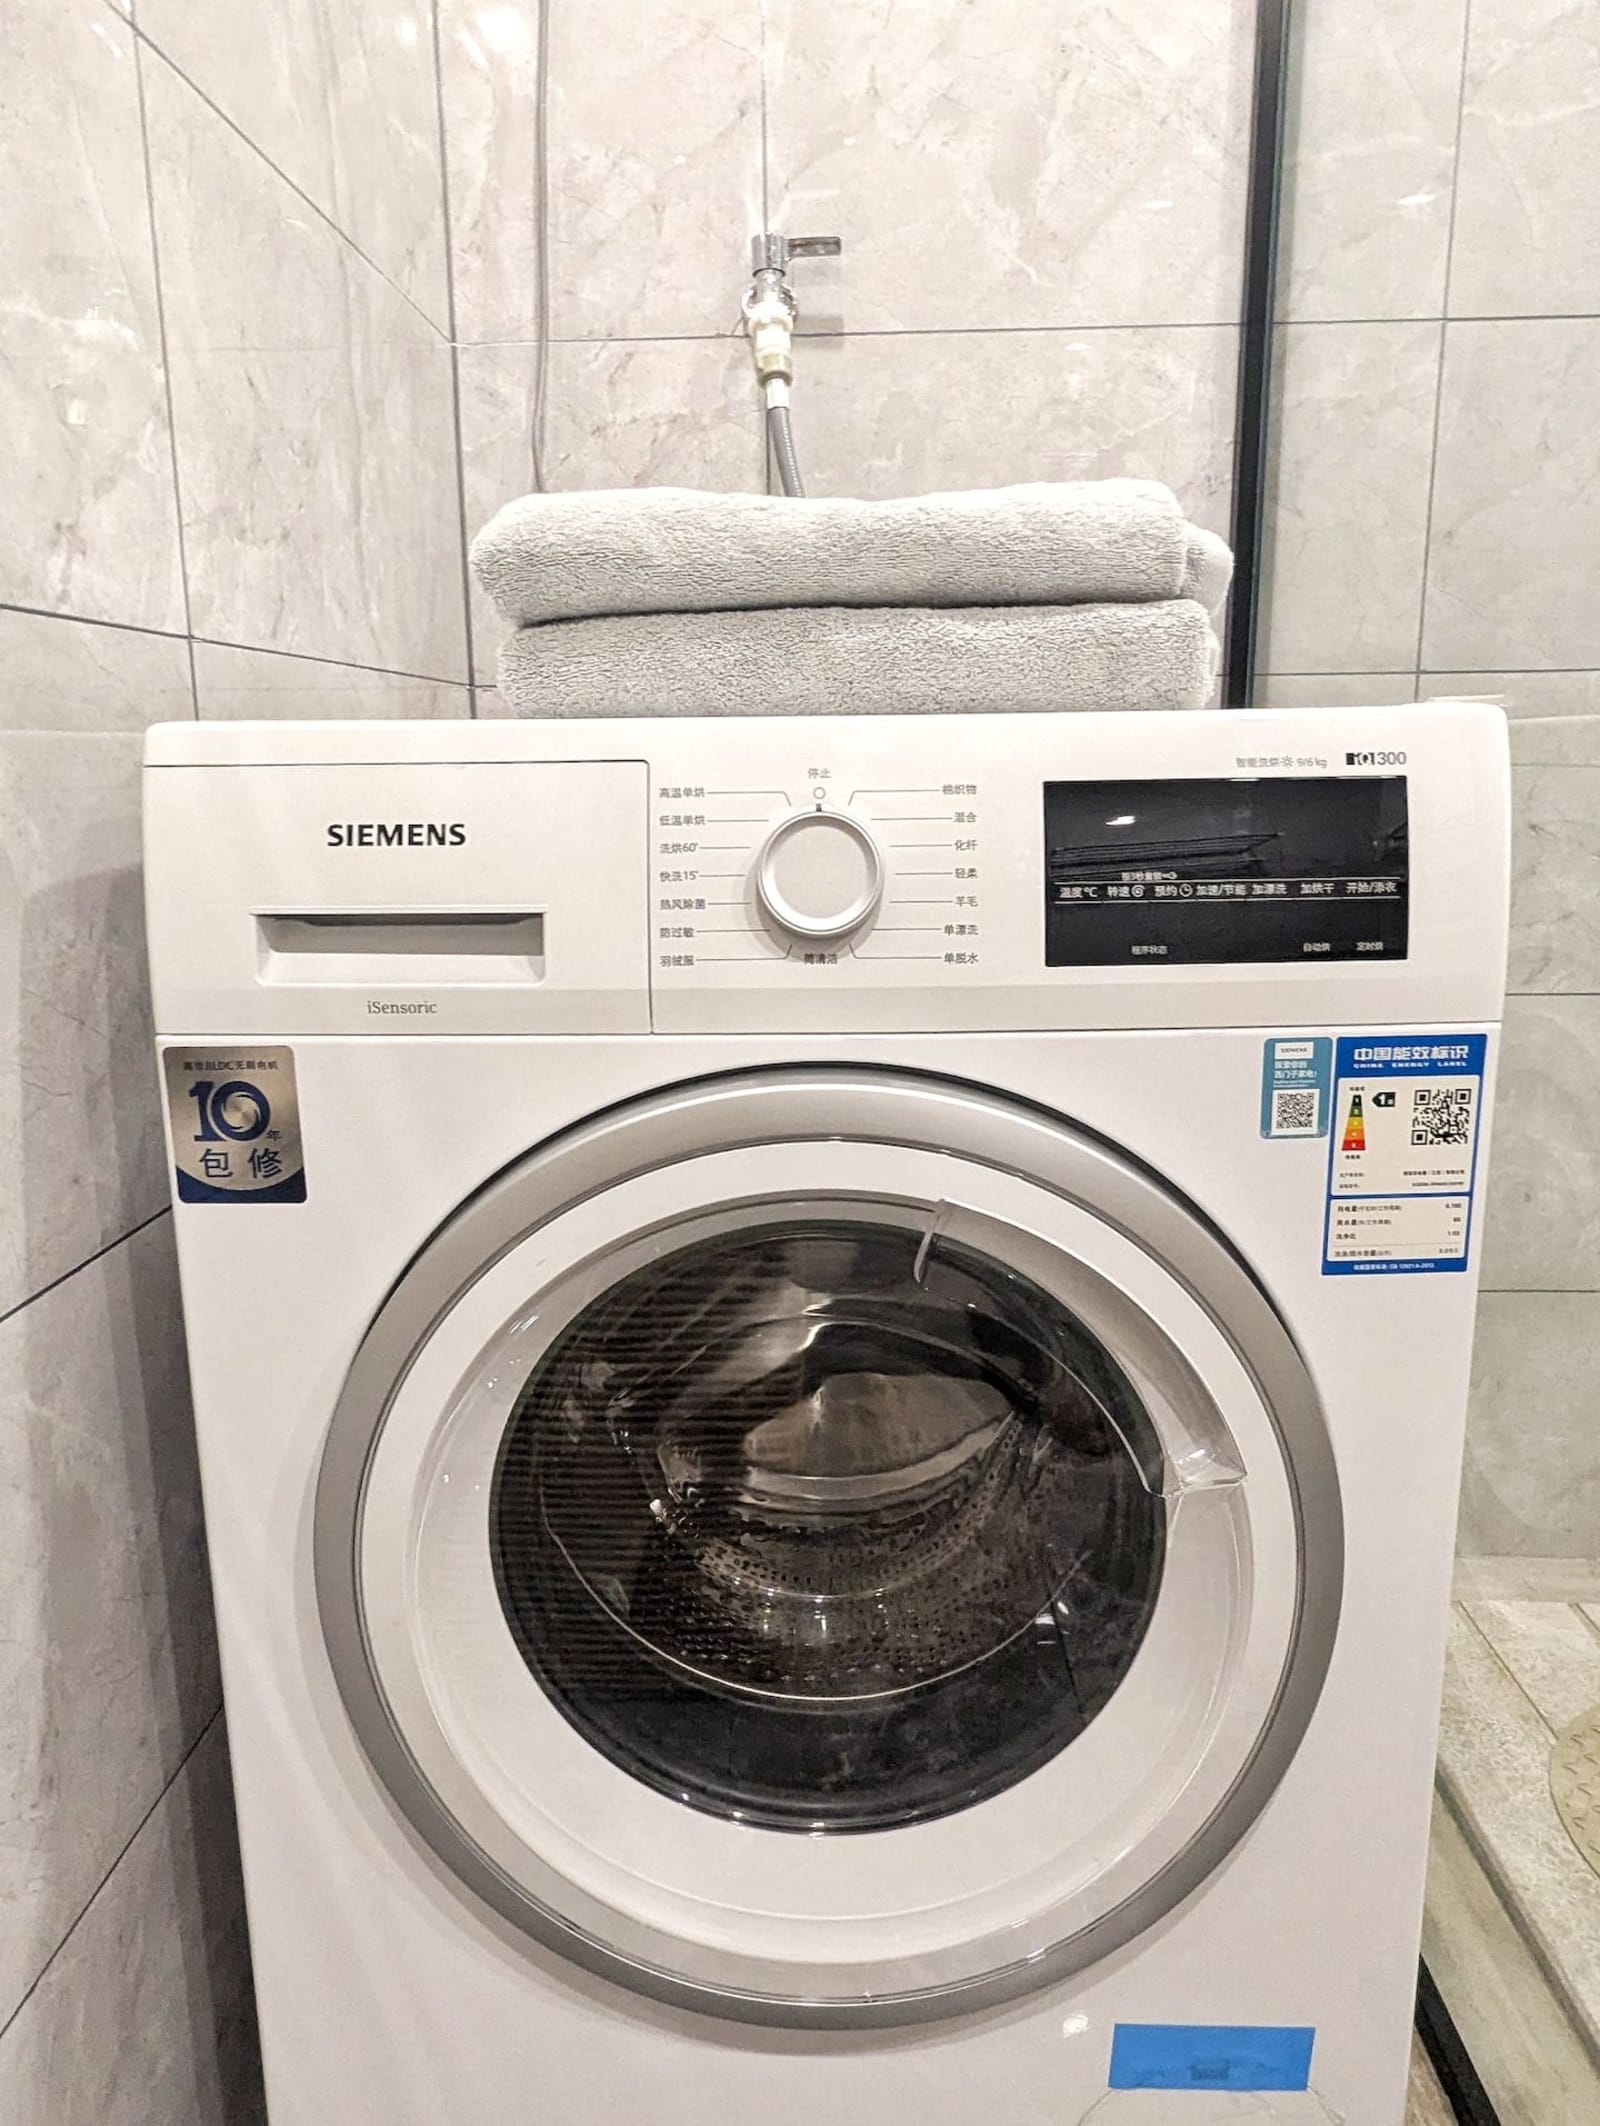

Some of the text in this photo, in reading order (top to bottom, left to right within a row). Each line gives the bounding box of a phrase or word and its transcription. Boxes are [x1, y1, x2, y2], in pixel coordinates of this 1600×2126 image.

[808, 768, 832, 779] 停止
[659, 788, 705, 799] 高温单烘
[659, 815, 705, 826] 低温单烘
[954, 811, 977, 823] 混合
[327, 823, 466, 847] SIEMENS
[954, 839, 977, 851] 化纤
[955, 868, 977, 879] 轻柔
[1107, 886, 1131, 898] 转速
[1154, 885, 1178, 897] 预约
[1196, 884, 1247, 896] 加速/节能
[1252, 883, 1288, 895] 加漂洗
[1301, 882, 1335, 894] 加烘干
[1346, 881, 1397, 893] 开始/添衣
[659, 898, 706, 910] 热风除菌
[956, 896, 978, 907] 羊毛
[659, 927, 694, 938] 防过敏
[944, 924, 979, 936] 单漂洗
[659, 955, 694, 967] 羽绒服
[944, 952, 979, 964] 单脱水
[367, 1000, 438, 1015] iSensoric
[1353, 1045, 1469, 1061] 中国能效标识
